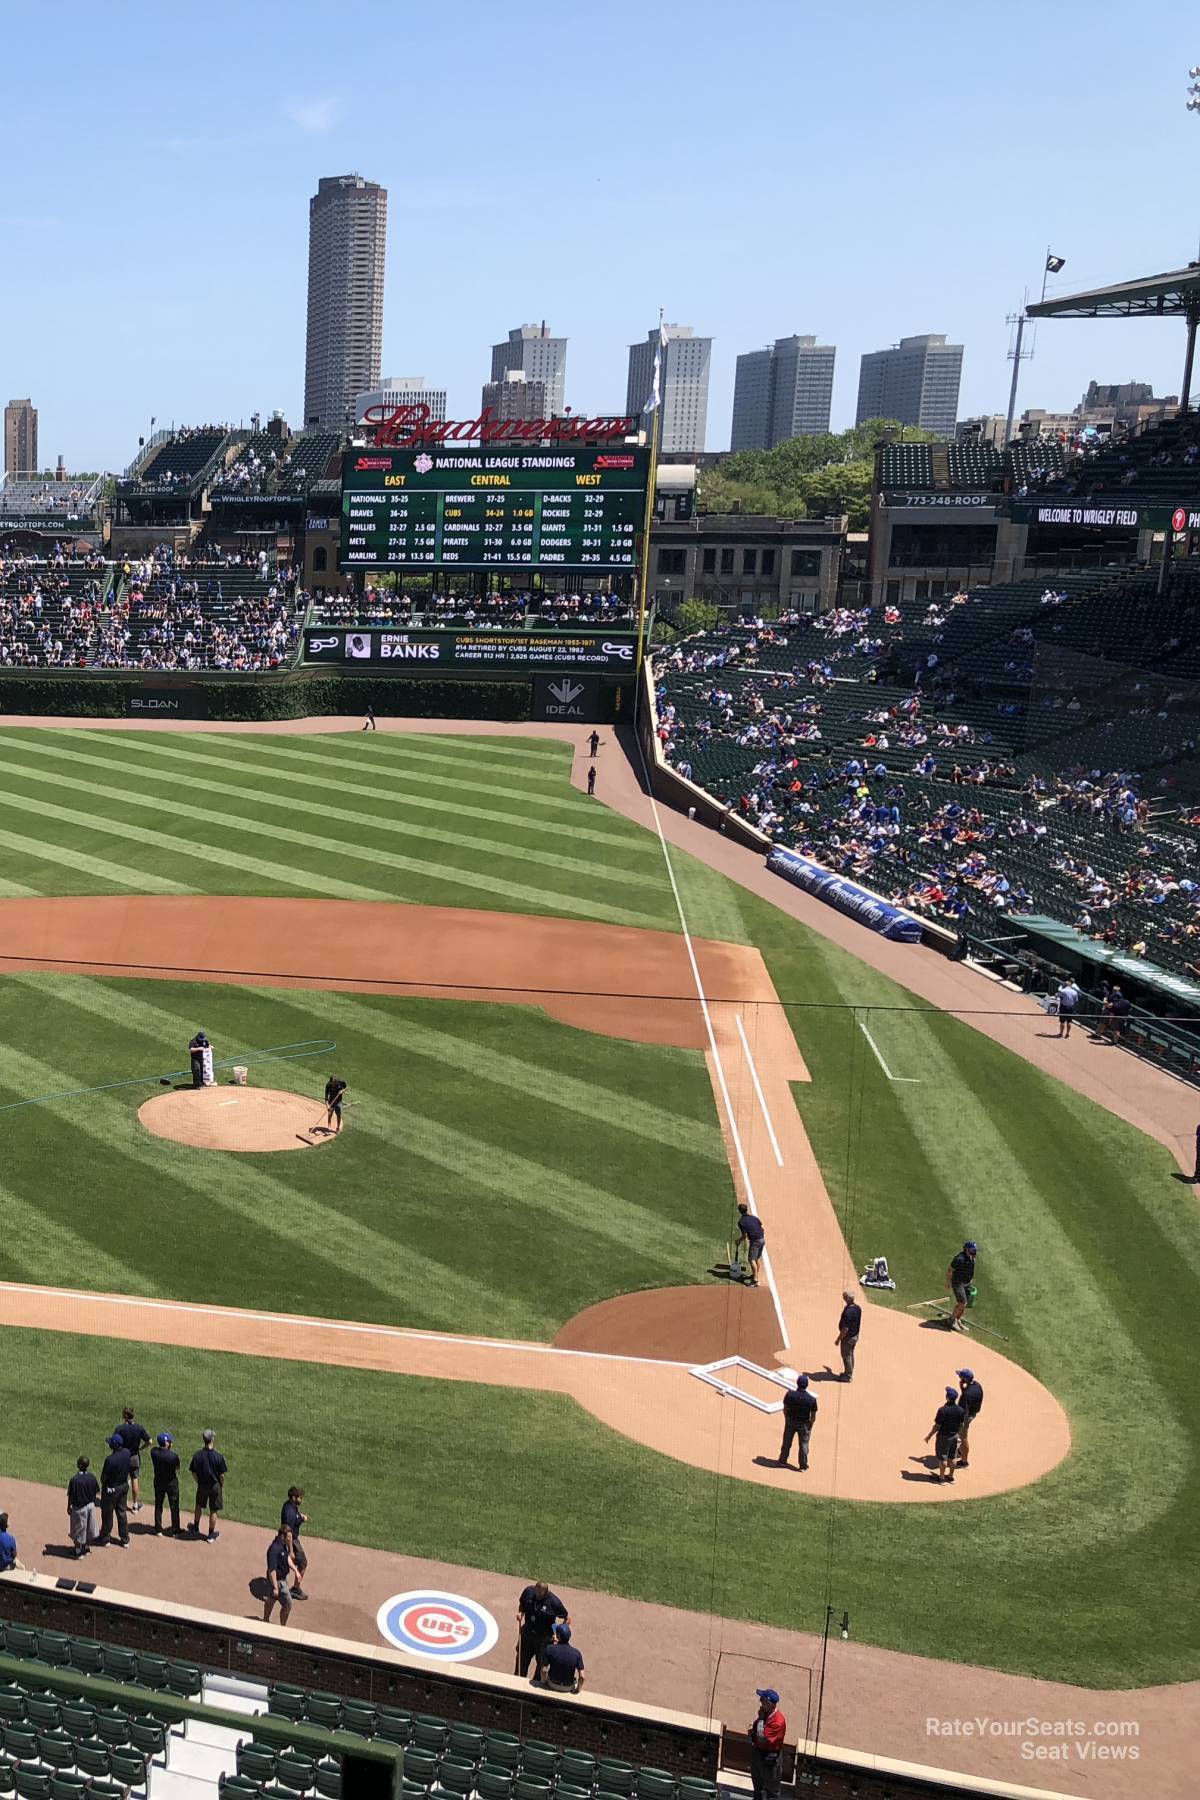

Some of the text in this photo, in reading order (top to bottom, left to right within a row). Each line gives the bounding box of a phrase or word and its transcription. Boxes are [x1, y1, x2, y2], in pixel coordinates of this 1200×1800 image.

[364, 402, 633, 448] Budweiser
[436, 457, 575, 469] NATIONAL LEAGUE STANDINGS
[384, 476, 405, 486] EAST
[471, 475, 510, 485] CENTRAL
[576, 475, 601, 485] WEST
[906, 496, 987, 505] 773-248-ROOF
[1038, 508, 1137, 526] WELCOME TO WRIGLEY FIELD
[381, 635, 408, 643] ERNIE
[380, 645, 440, 658] BANKS
[131, 699, 178, 708] SLOAN
[546, 705, 584, 715] IDEAL
[859, 900, 884, 924] Wrap
